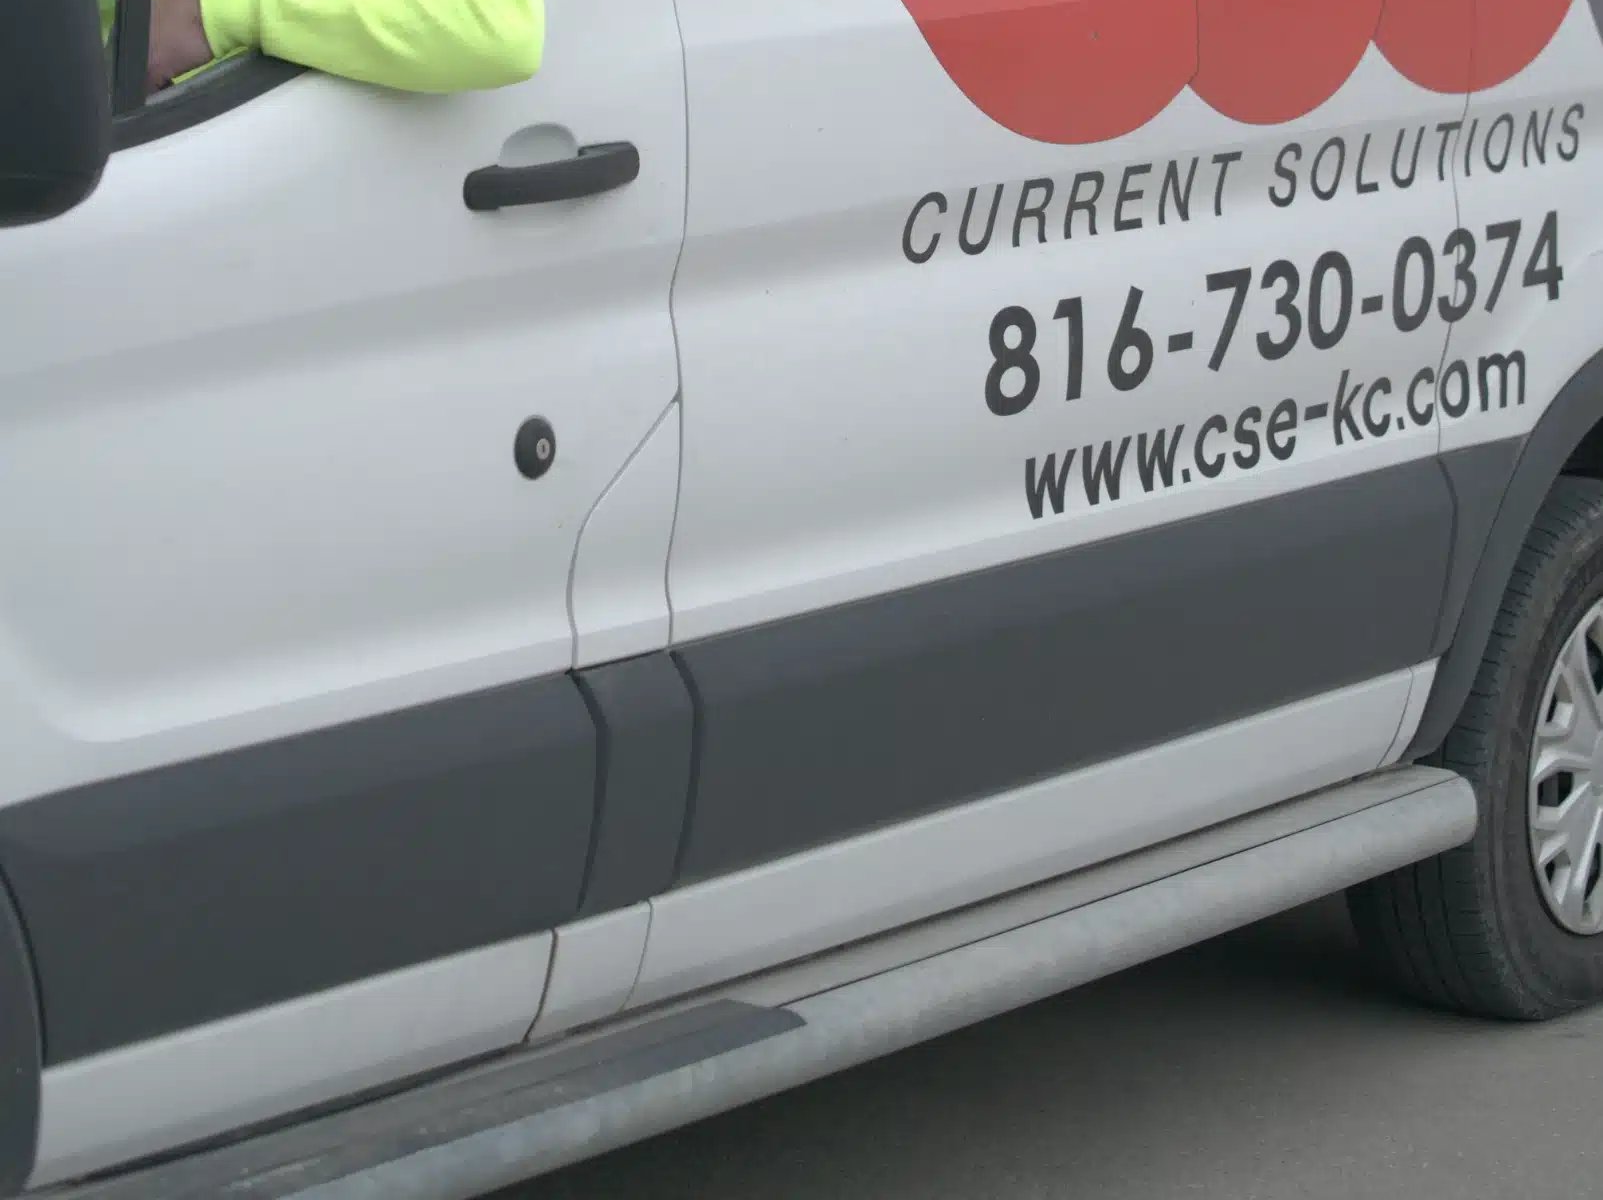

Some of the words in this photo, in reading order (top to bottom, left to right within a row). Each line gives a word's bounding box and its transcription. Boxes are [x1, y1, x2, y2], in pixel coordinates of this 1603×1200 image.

[902, 150, 1242, 264] CURRENT
[1268, 103, 1585, 208] SOLUTIONS
[984, 211, 1564, 417] 816-730-0374
[1025, 349, 1527, 520] www.cse-kc.com
